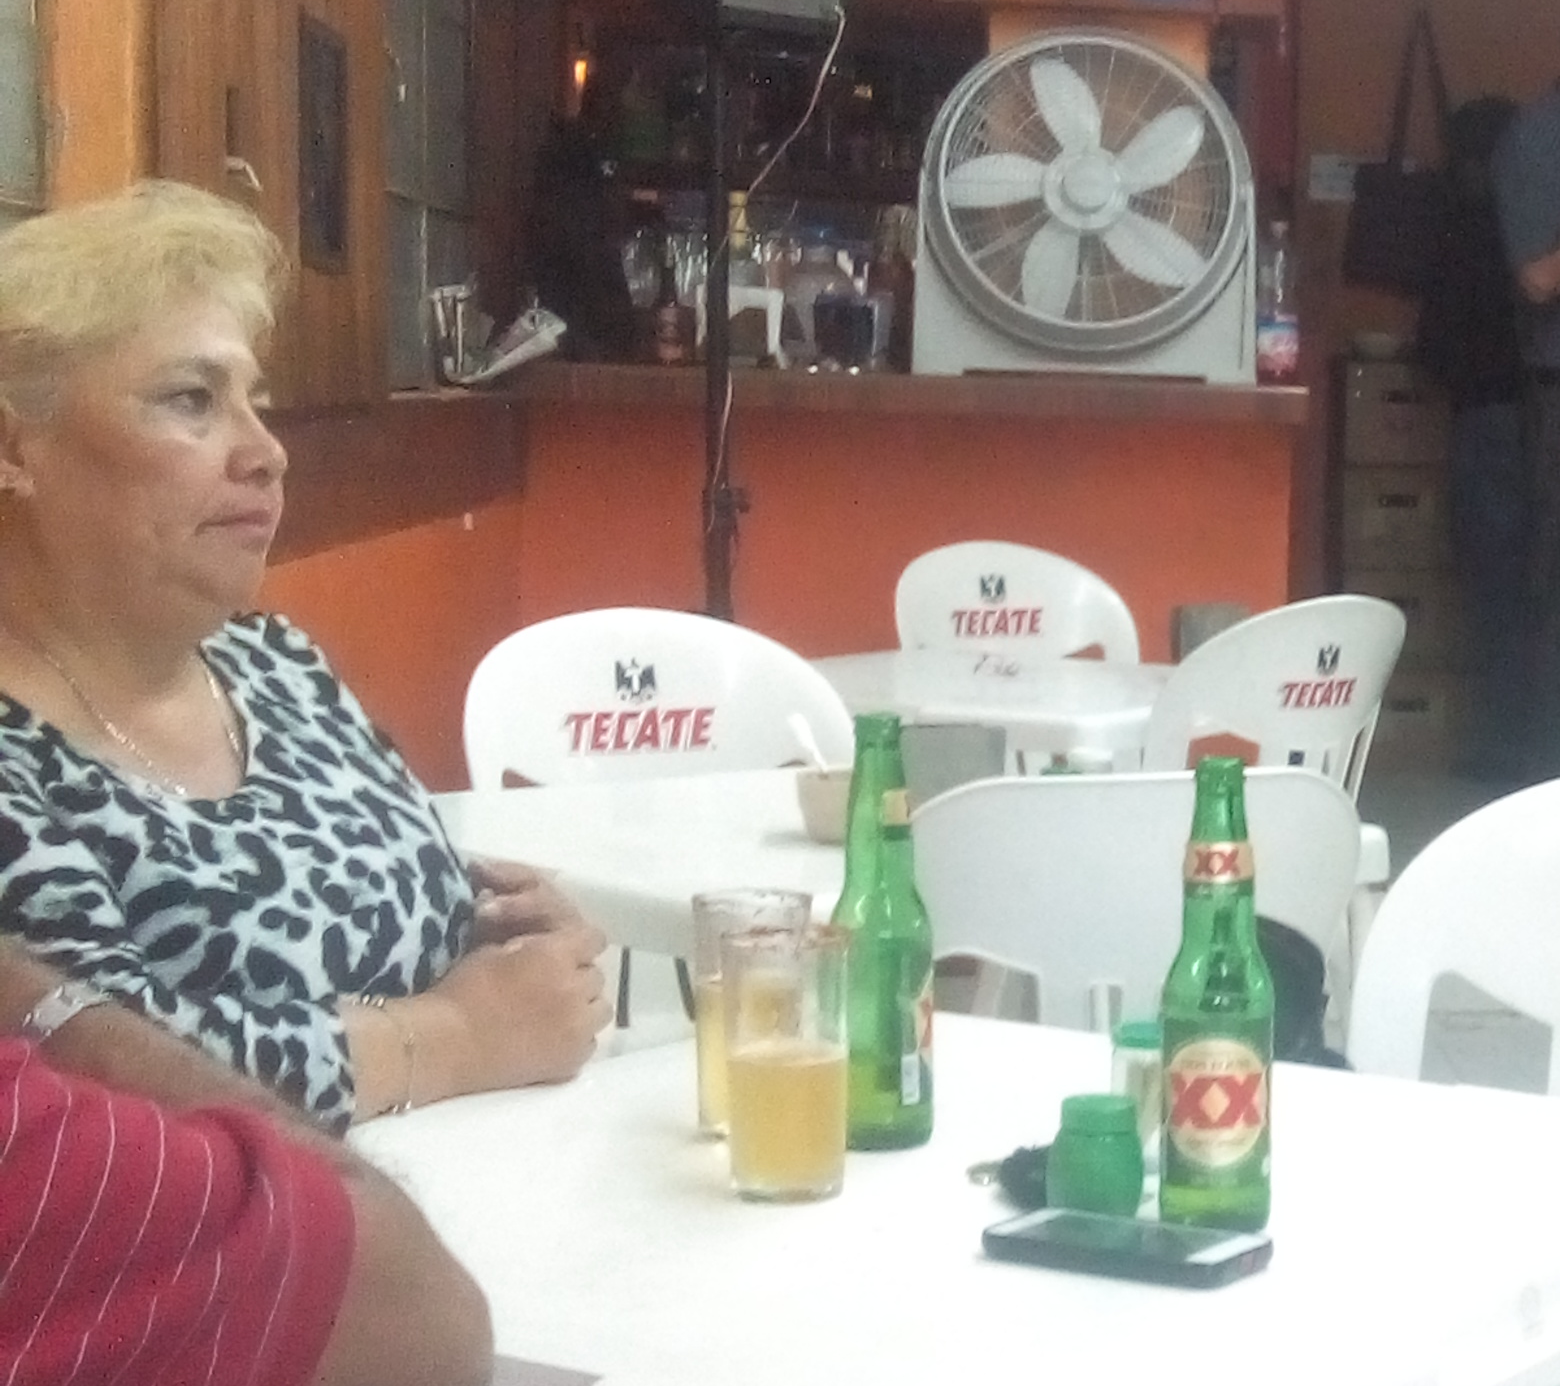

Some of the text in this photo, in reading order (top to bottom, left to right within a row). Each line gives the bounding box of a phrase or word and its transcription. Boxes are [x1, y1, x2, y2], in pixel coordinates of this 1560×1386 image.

[951, 607, 1043, 636] TECATE
[563, 706, 716, 753] TECATE
[1169, 1072, 1263, 1130] XX
